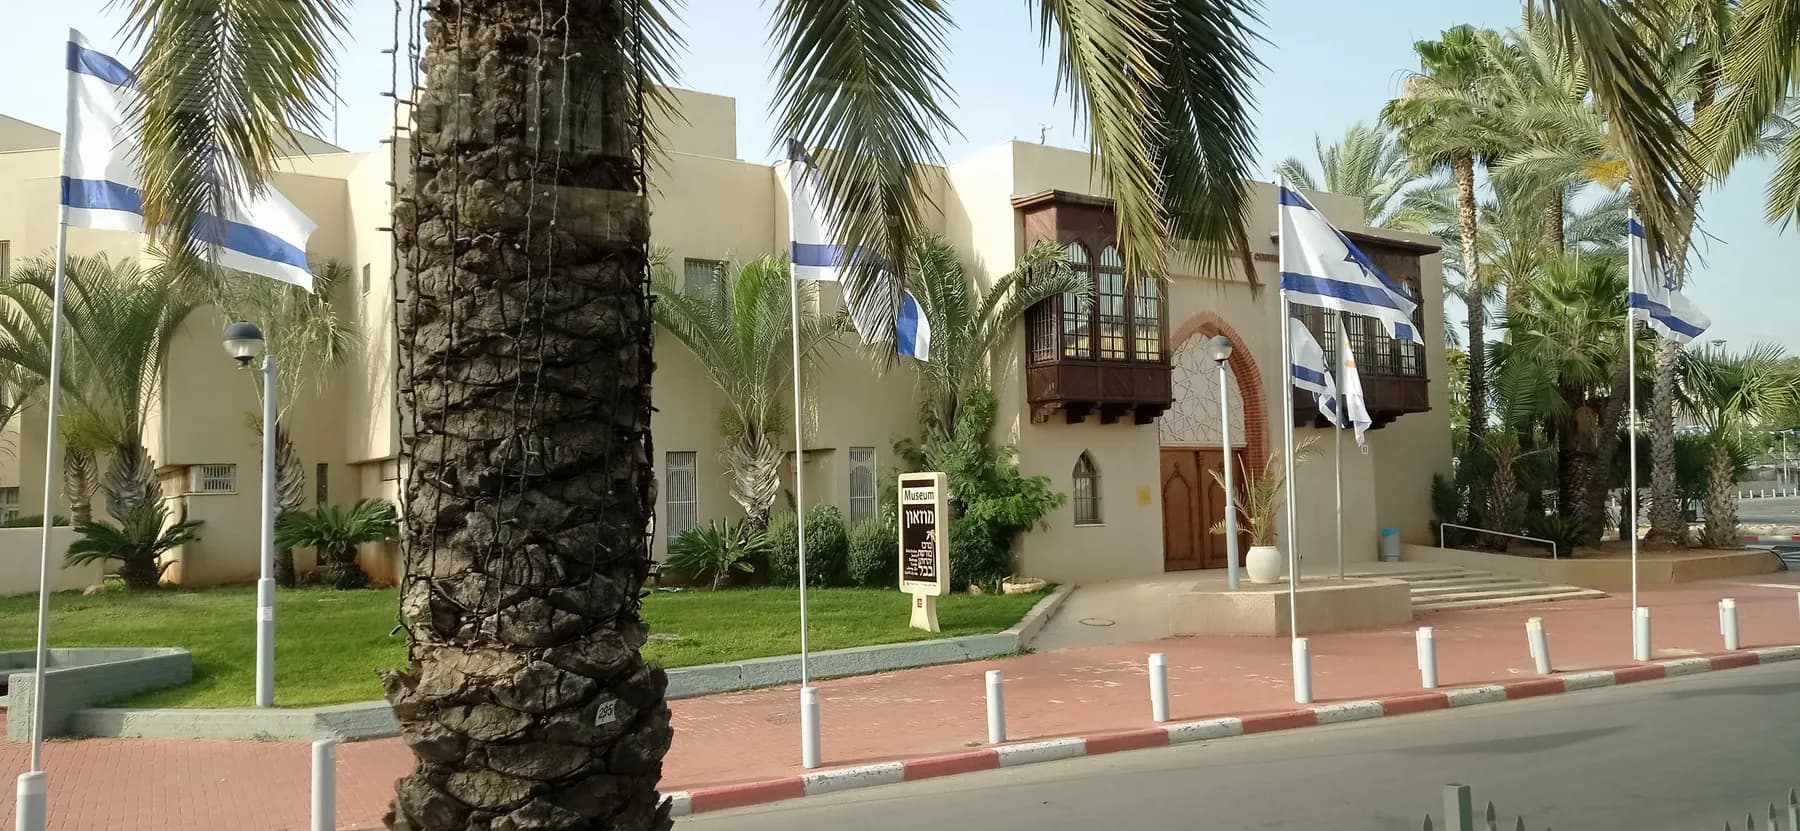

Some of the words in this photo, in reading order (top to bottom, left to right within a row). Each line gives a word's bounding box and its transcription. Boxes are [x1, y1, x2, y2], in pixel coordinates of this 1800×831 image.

[904, 489, 935, 501] Museum
[905, 509, 935, 529] מוזאון
[598, 703, 614, 719] 295
